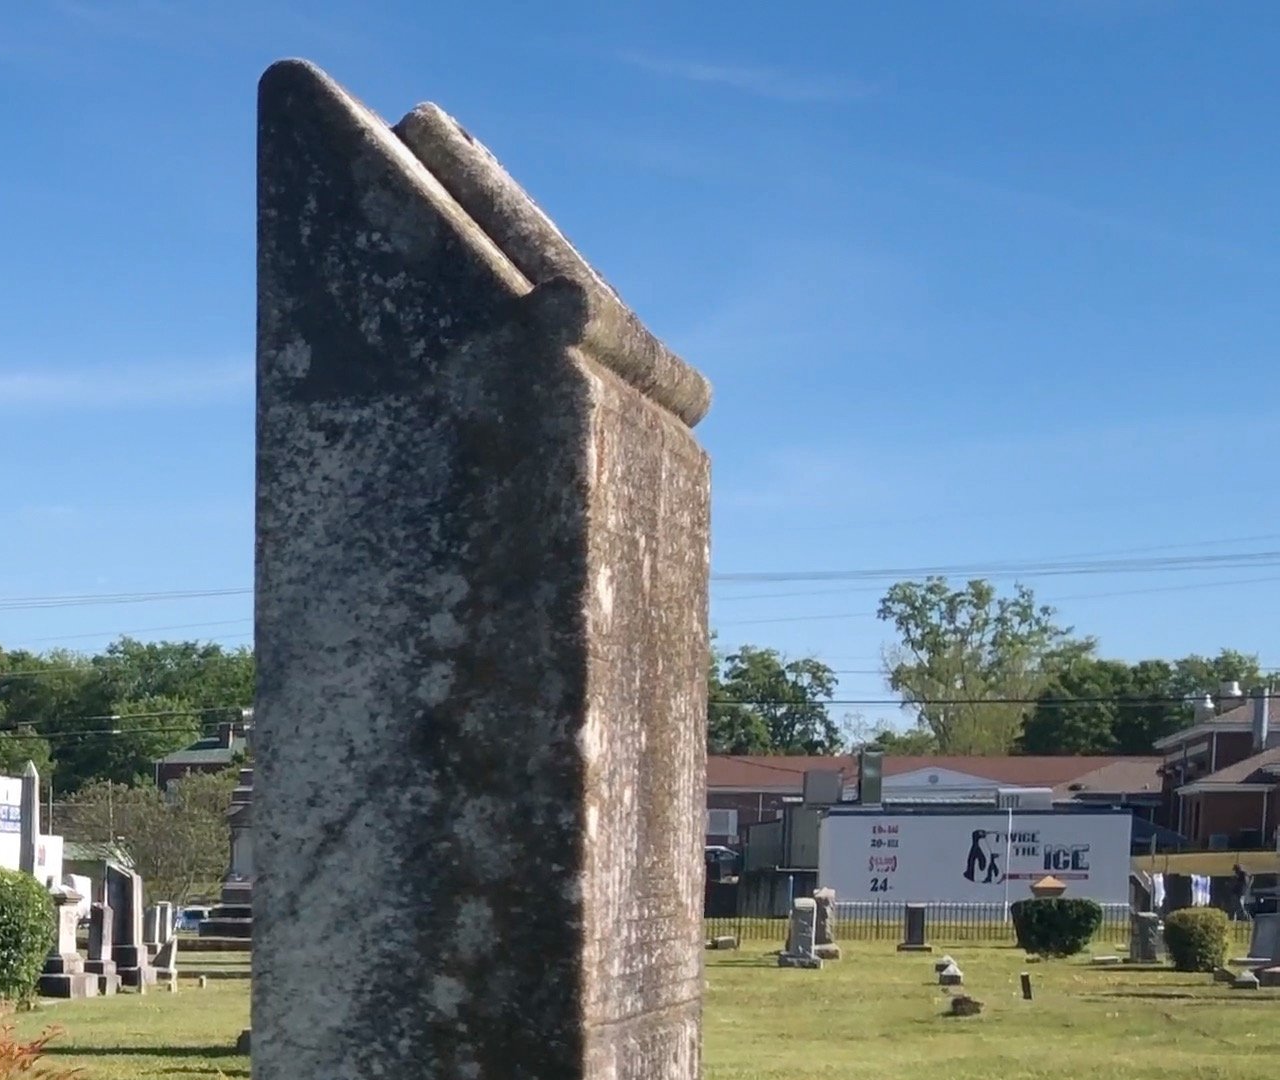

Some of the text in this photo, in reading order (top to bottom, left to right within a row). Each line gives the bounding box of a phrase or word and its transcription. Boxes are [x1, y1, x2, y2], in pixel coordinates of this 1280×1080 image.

[995, 830, 1040, 843] TWICE
[1013, 845, 1040, 856] THE
[1043, 844, 1090, 870] ICE
